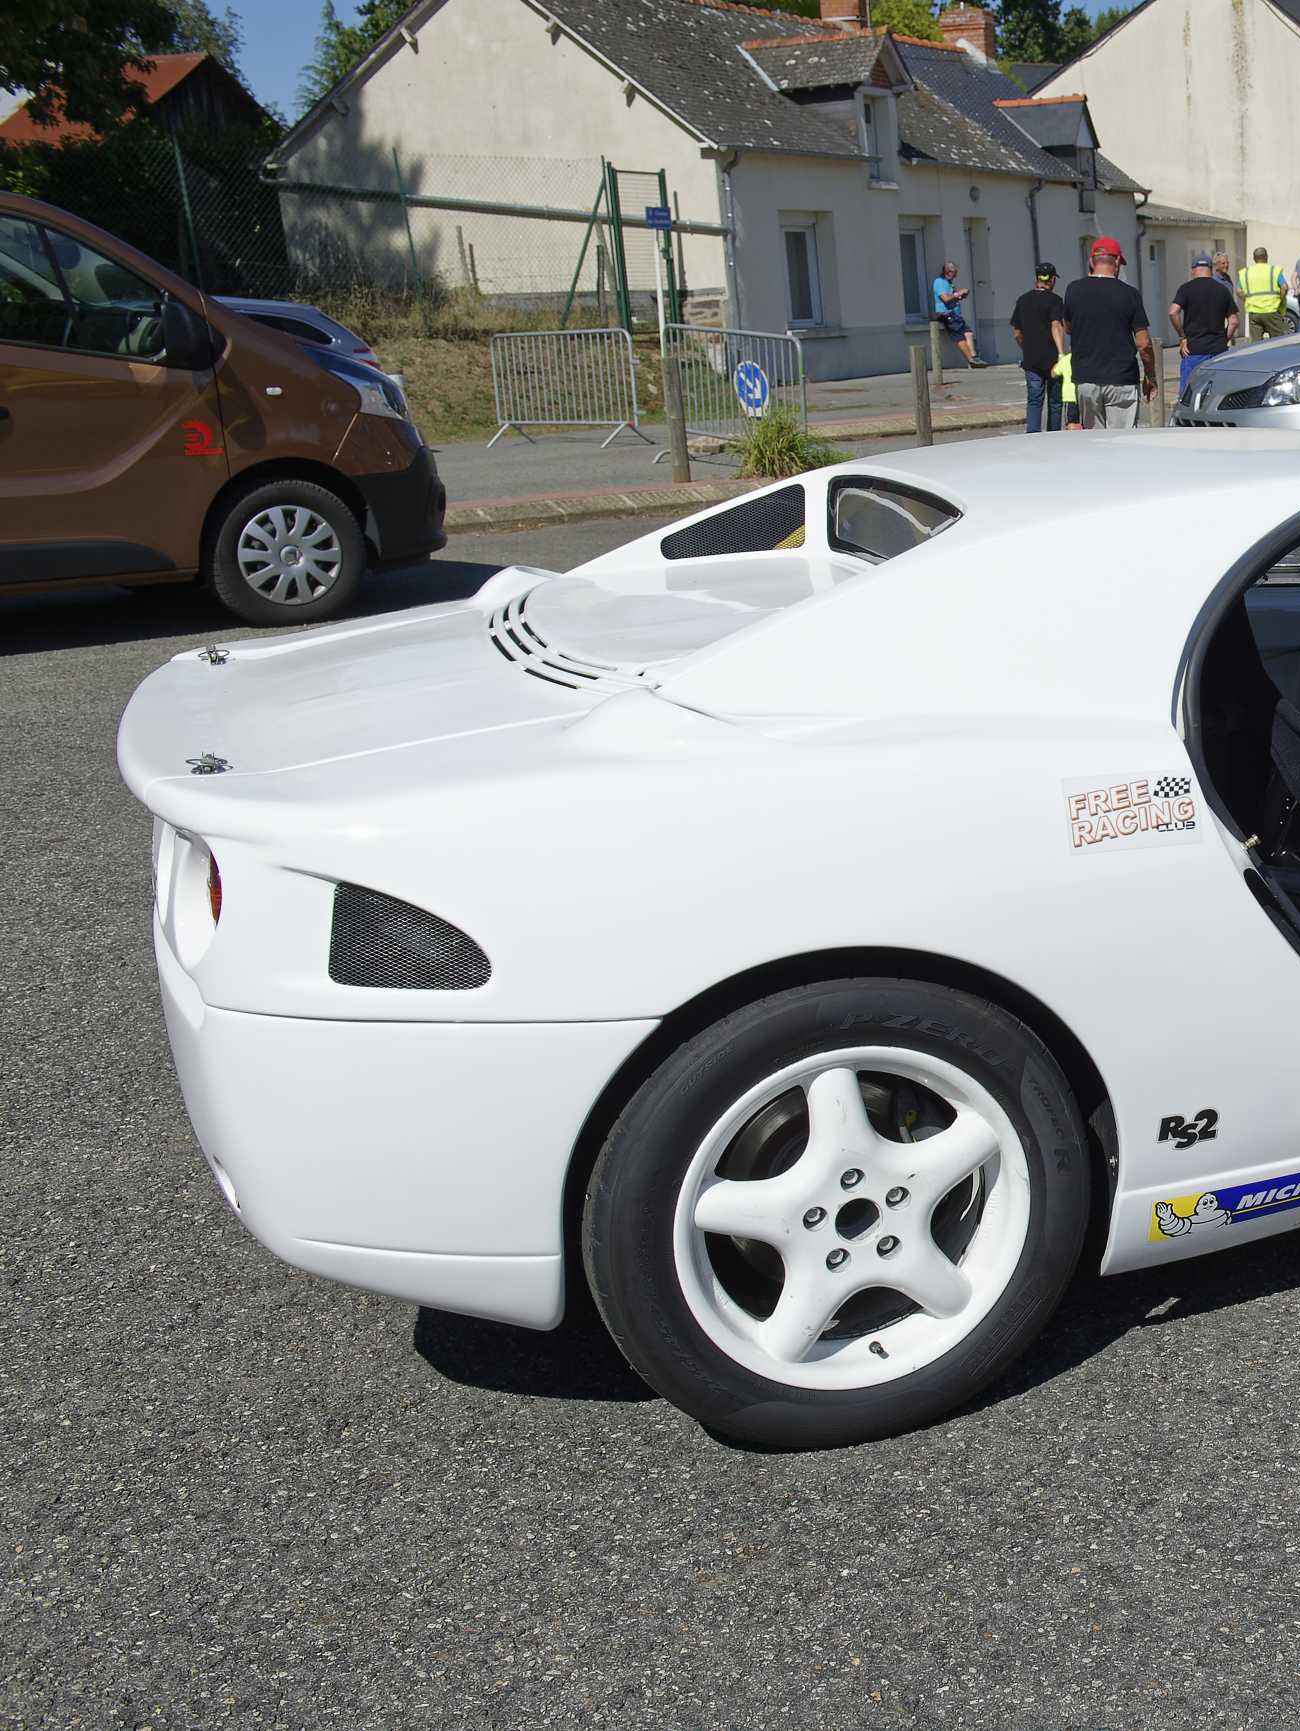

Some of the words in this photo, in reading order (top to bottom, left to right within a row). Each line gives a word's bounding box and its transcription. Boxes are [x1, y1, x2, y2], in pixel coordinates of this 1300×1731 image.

[1068, 779, 1152, 821] FREE
[1072, 796, 1195, 848] RACING
[1158, 1108, 1218, 1149] RS2
